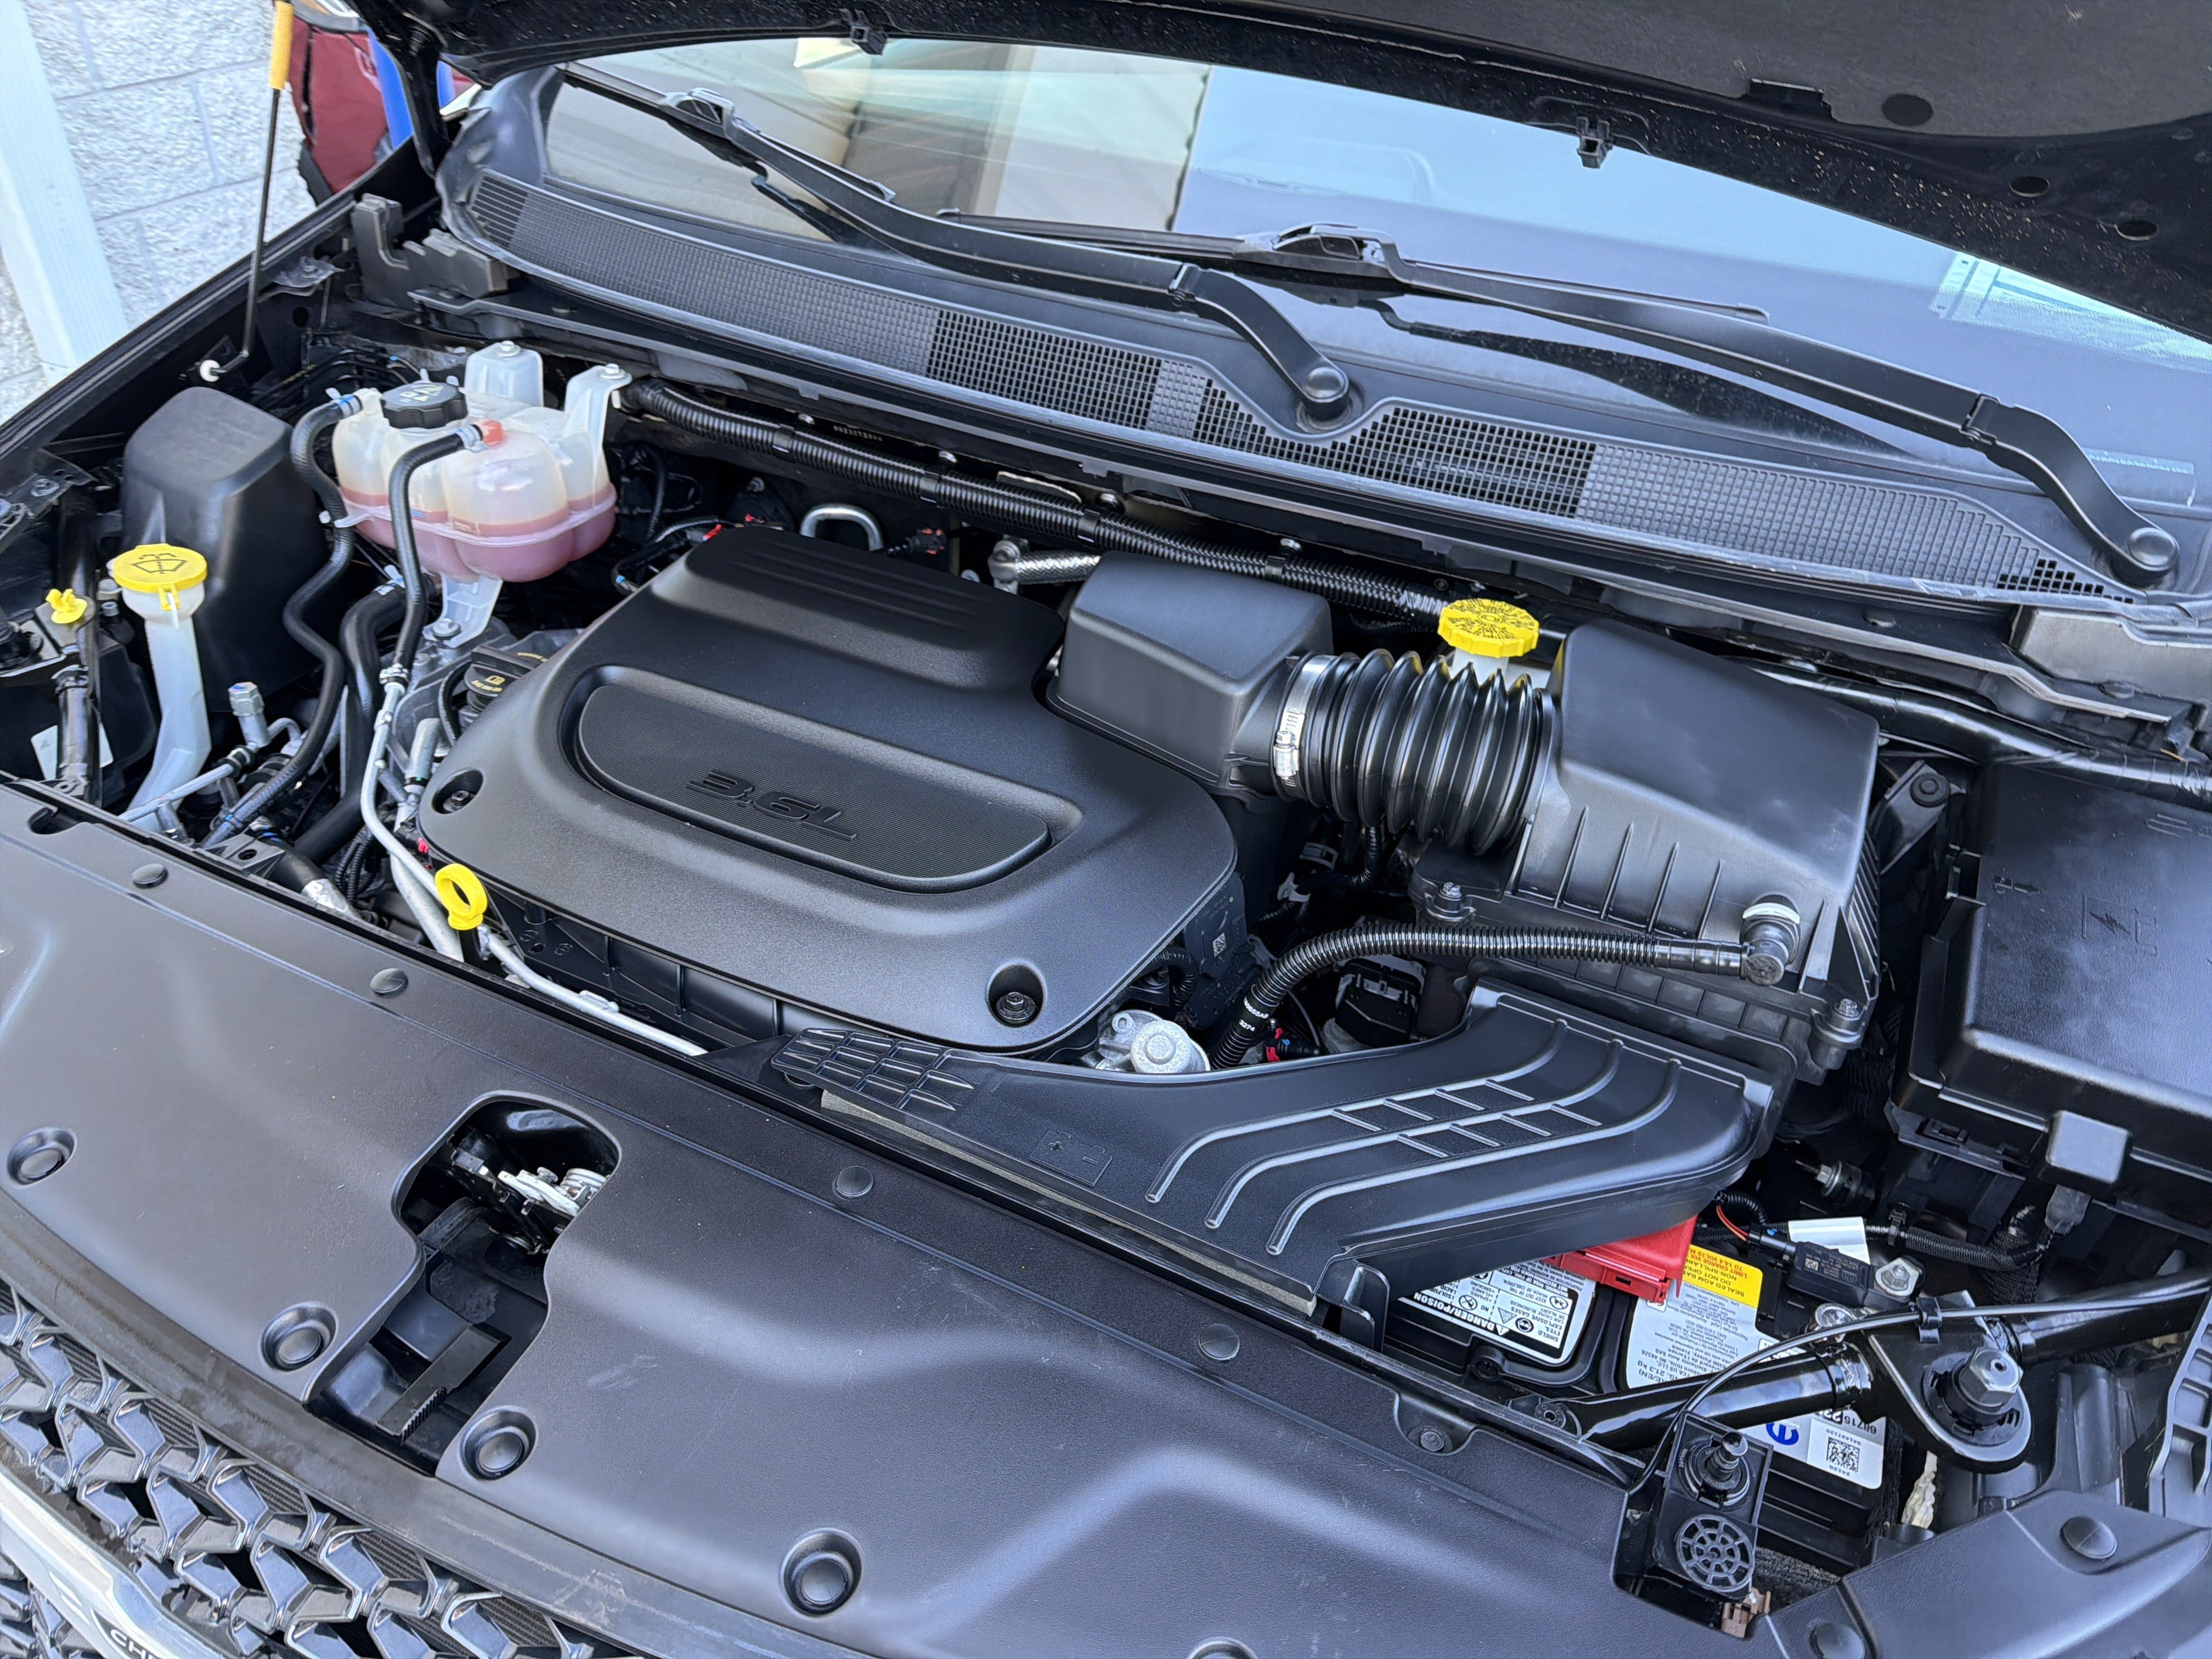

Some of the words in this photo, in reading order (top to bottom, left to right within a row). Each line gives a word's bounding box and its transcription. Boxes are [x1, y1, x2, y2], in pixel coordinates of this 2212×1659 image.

[686, 769, 857, 840] 3.6L
[1697, 1250, 1717, 1262] VOLTS
[1703, 1257, 1728, 1272] CHARGE
[1719, 1258, 1731, 1267] 14.4
[1704, 1272, 1718, 1282] NOT
[1730, 1267, 1747, 1279] LIMIT
[1697, 1275, 1713, 1286] AGM
[1720, 1277, 1731, 1286] DO
[1716, 1281, 1744, 1297] SEALED
[1414, 1293, 1494, 1329] DANGER/POISON
[1511, 1306, 1529, 1317] GASES
[1532, 1314, 1561, 1330] EXPLOSIVE
[1538, 1330, 1558, 1342] SHIELD
[1637, 1360, 1647, 1369] kg
[1649, 1365, 1664, 1376] 21.3
